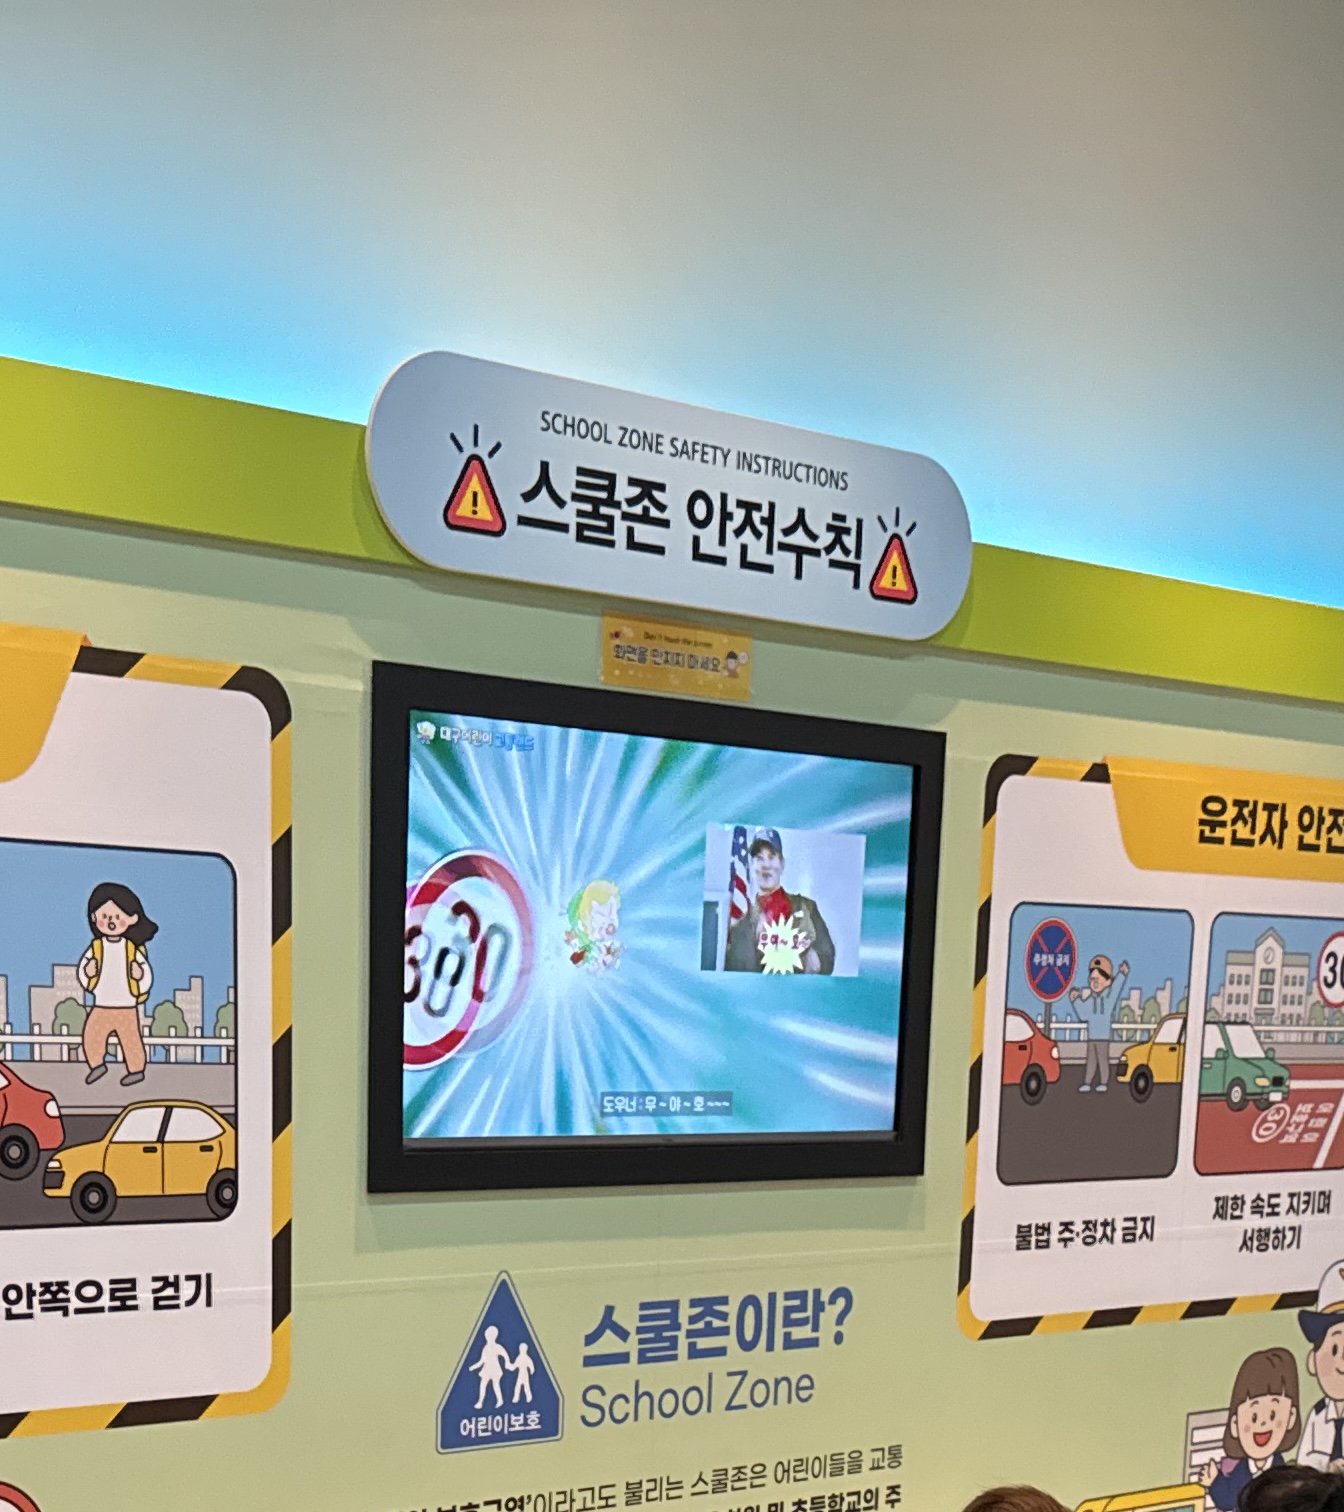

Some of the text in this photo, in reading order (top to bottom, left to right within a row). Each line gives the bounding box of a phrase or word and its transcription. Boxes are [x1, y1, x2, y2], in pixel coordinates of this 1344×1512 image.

[540, 411, 849, 491] SCHOOL ZONE SAFETY INSTRUCTIONS
[516, 460, 863, 589] 스쿨존 안전수칙
[1198, 795, 1288, 850] 운전자
[1212, 1189, 1332, 1221] 제한 속도 지키며
[1015, 1215, 1156, 1252] 불법 주·정차 금지
[1238, 1224, 1302, 1254] 서행하기
[1, 1275, 139, 1321] 안쪽으로
[150, 1272, 214, 1311] 걷기
[582, 1285, 854, 1368] 스쿨존이란?
[459, 1410, 542, 1438] 어린이보호
[580, 1370, 816, 1428] School Zone
[624, 1474, 684, 1508] 불리는
[690, 1462, 768, 1498] 스쿨존은
[773, 1449, 864, 1485] 어린이들을
[868, 1443, 903, 1472] 교통
[884, 1484, 902, 1509] 주
